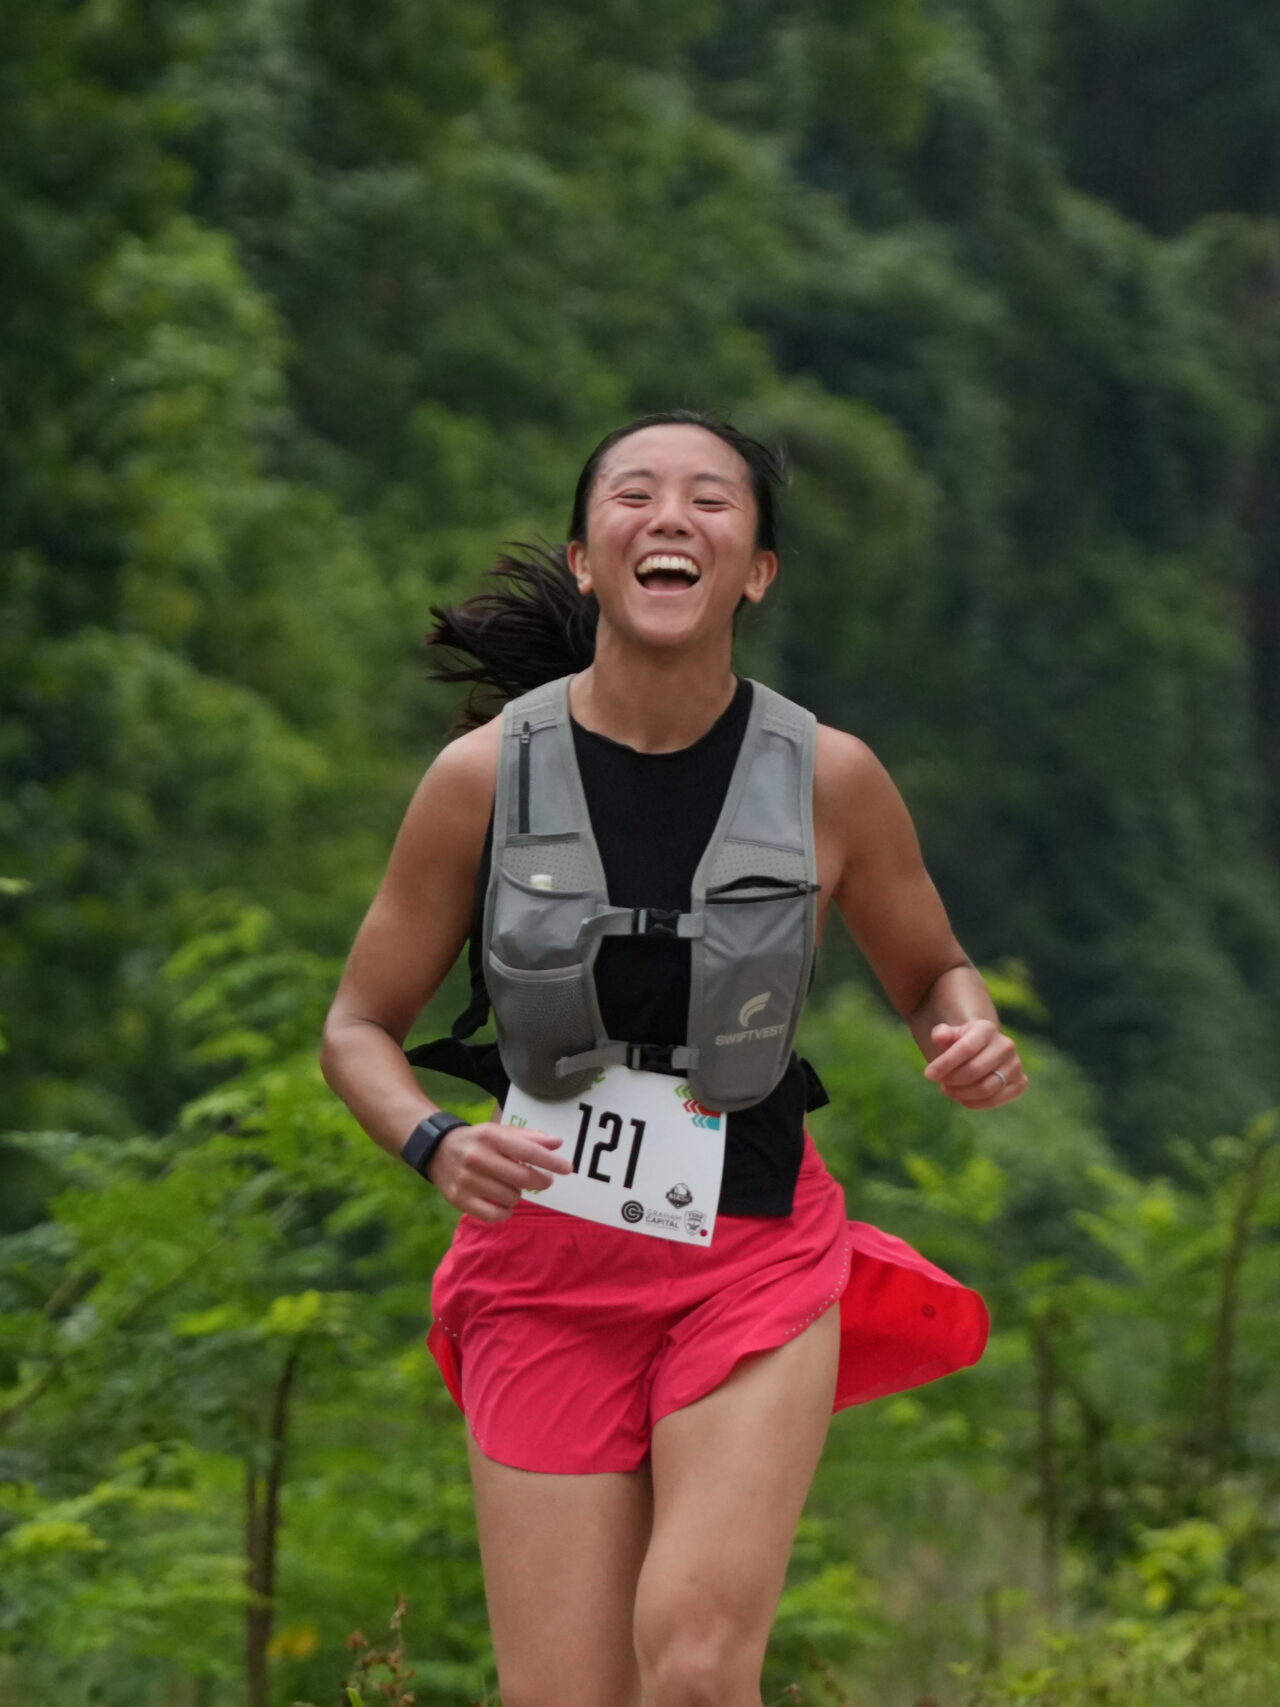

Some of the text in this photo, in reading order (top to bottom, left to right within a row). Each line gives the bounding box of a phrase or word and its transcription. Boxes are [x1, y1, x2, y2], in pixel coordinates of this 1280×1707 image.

[715, 1024, 785, 1046] SWIFTVEST
[572, 1102, 646, 1189] 121
[645, 1216, 679, 1229] CAPITAL
